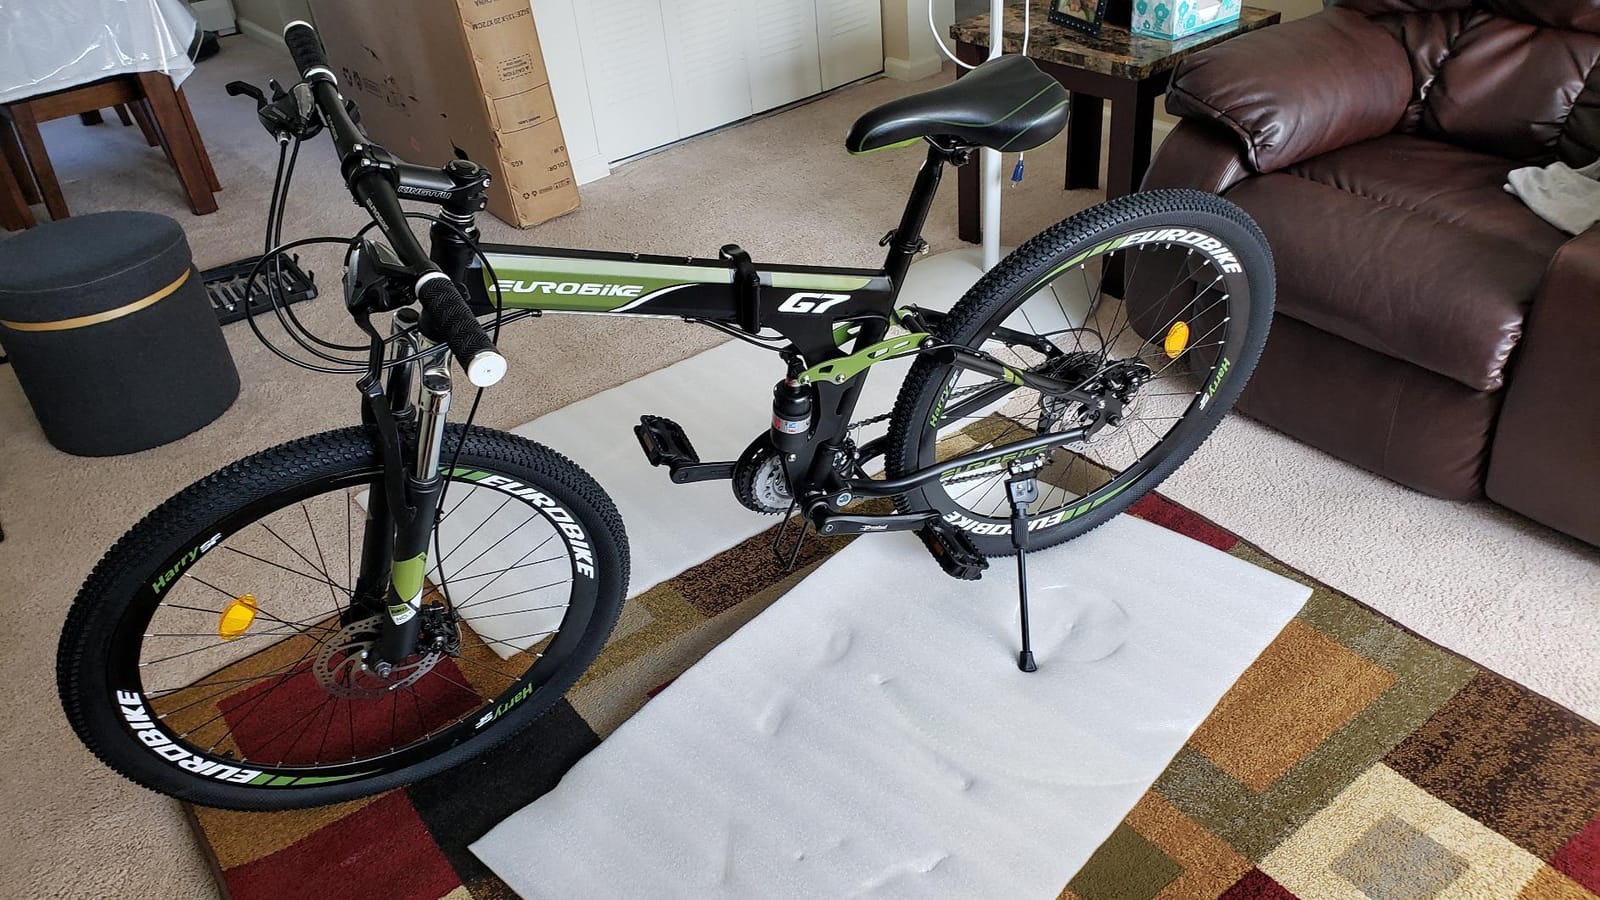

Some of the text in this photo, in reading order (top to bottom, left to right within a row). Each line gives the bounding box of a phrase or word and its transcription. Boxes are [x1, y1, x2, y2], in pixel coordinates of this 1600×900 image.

[1119, 228, 1242, 274] EUROBIKE
[777, 292, 851, 314] G7
[1208, 357, 1231, 397] Harry
[930, 384, 949, 428] Harry
[476, 475, 595, 580] EUROBIKE
[942, 511, 1066, 535] EUOBIKE
[151, 546, 199, 594] Harry
[493, 682, 533, 720] Harry
[116, 690, 263, 784] EUROBIKE
